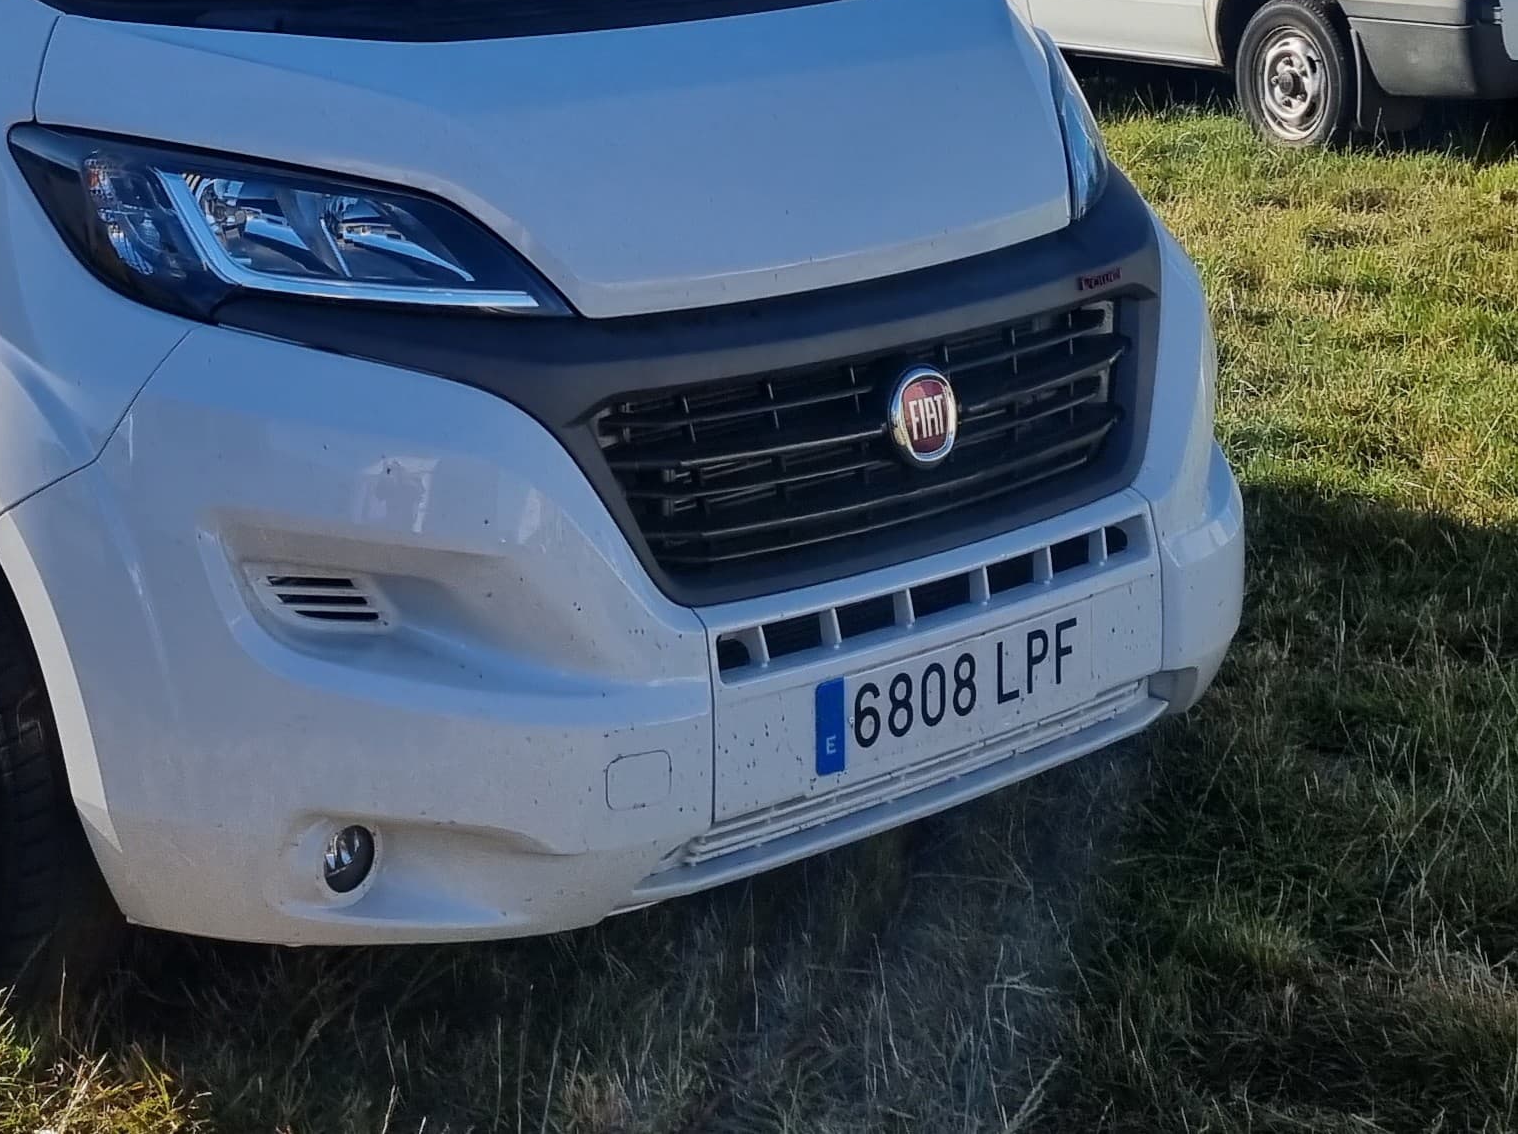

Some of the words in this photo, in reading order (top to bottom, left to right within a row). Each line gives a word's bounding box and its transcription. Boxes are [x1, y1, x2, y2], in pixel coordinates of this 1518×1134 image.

[908, 393, 944, 441] FIAT
[854, 652, 976, 748] 6808
[996, 617, 1078, 704] LPF
[826, 735, 837, 755] E
